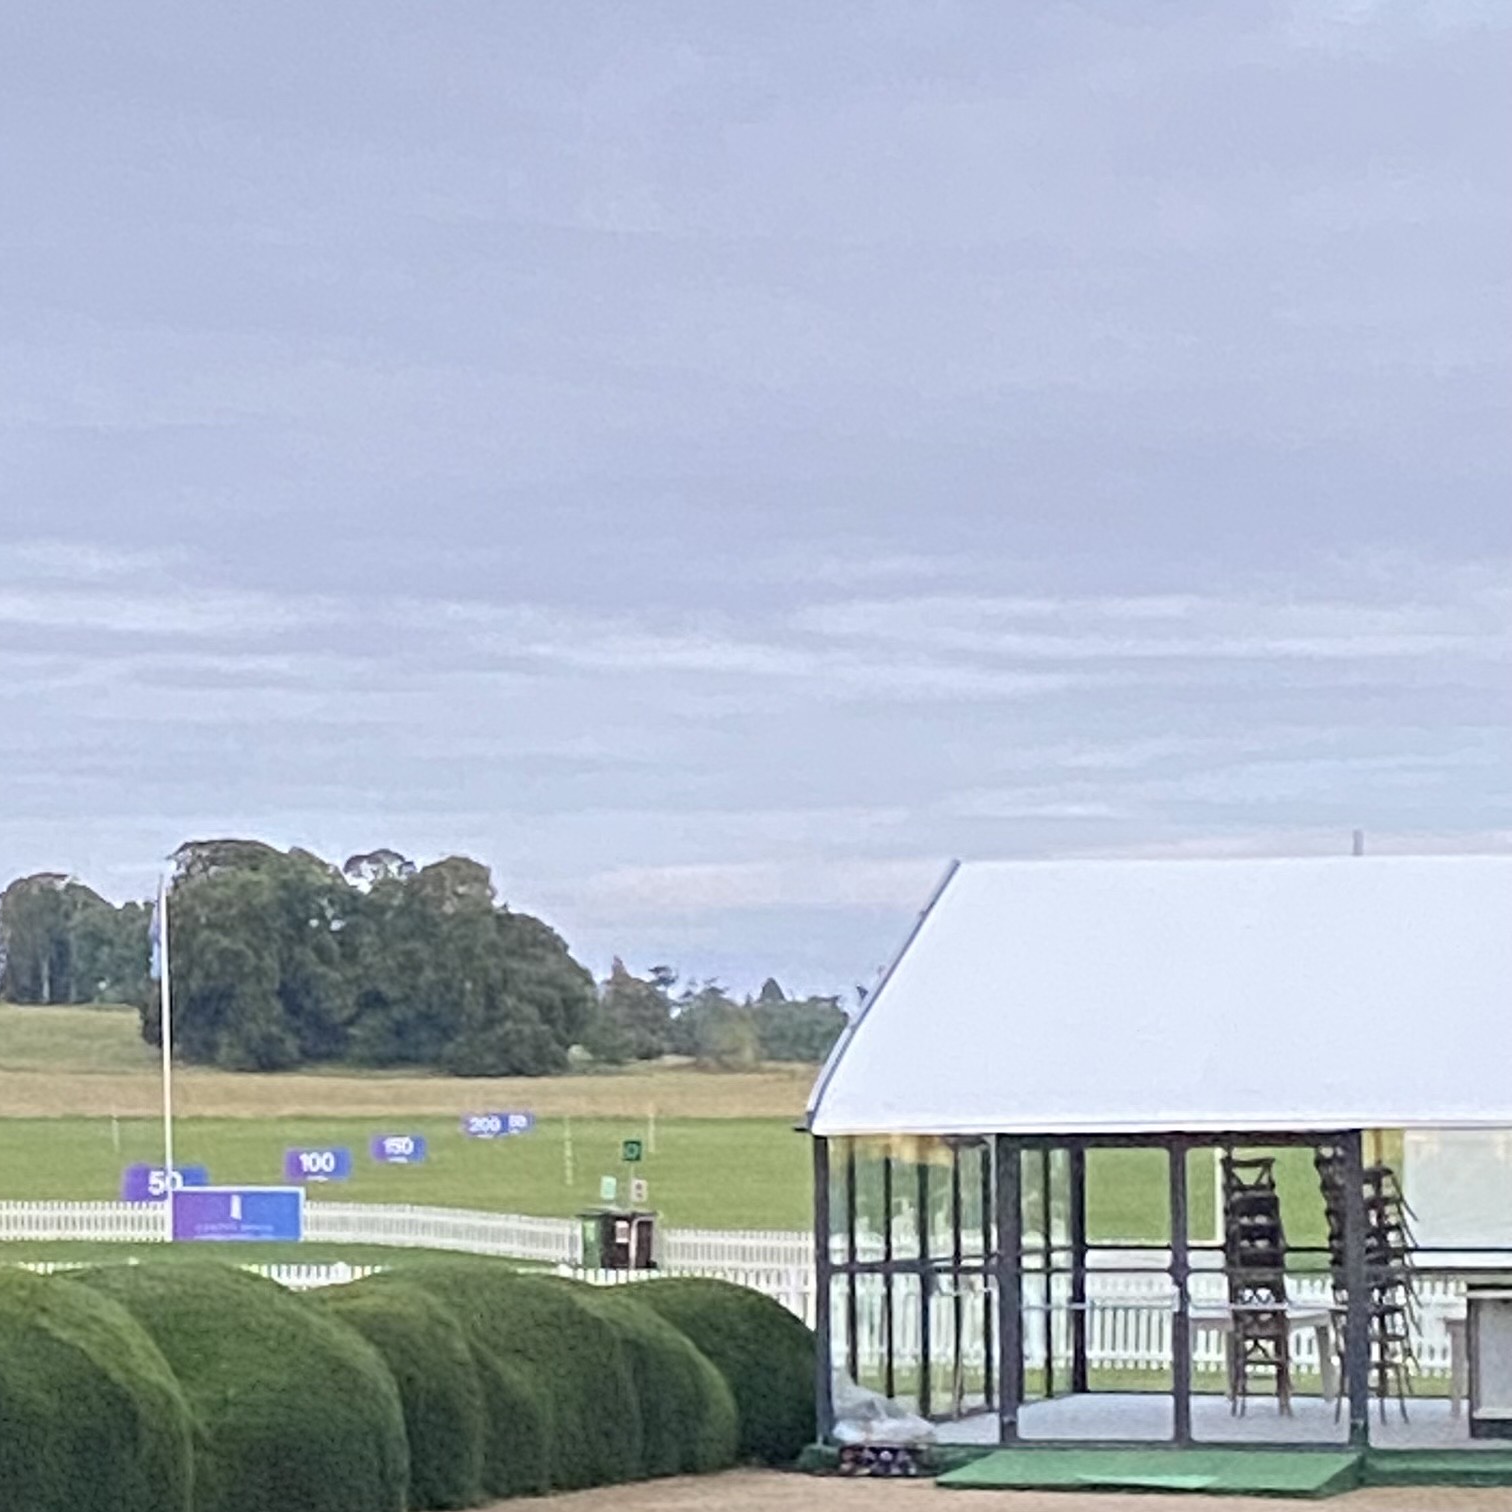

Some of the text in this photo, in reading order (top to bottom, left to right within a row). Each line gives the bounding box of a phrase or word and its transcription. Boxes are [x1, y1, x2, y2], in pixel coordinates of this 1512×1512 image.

[383, 1136, 414, 1154] 150
[299, 1152, 335, 1172] 100
[148, 1171, 183, 1195] 50
